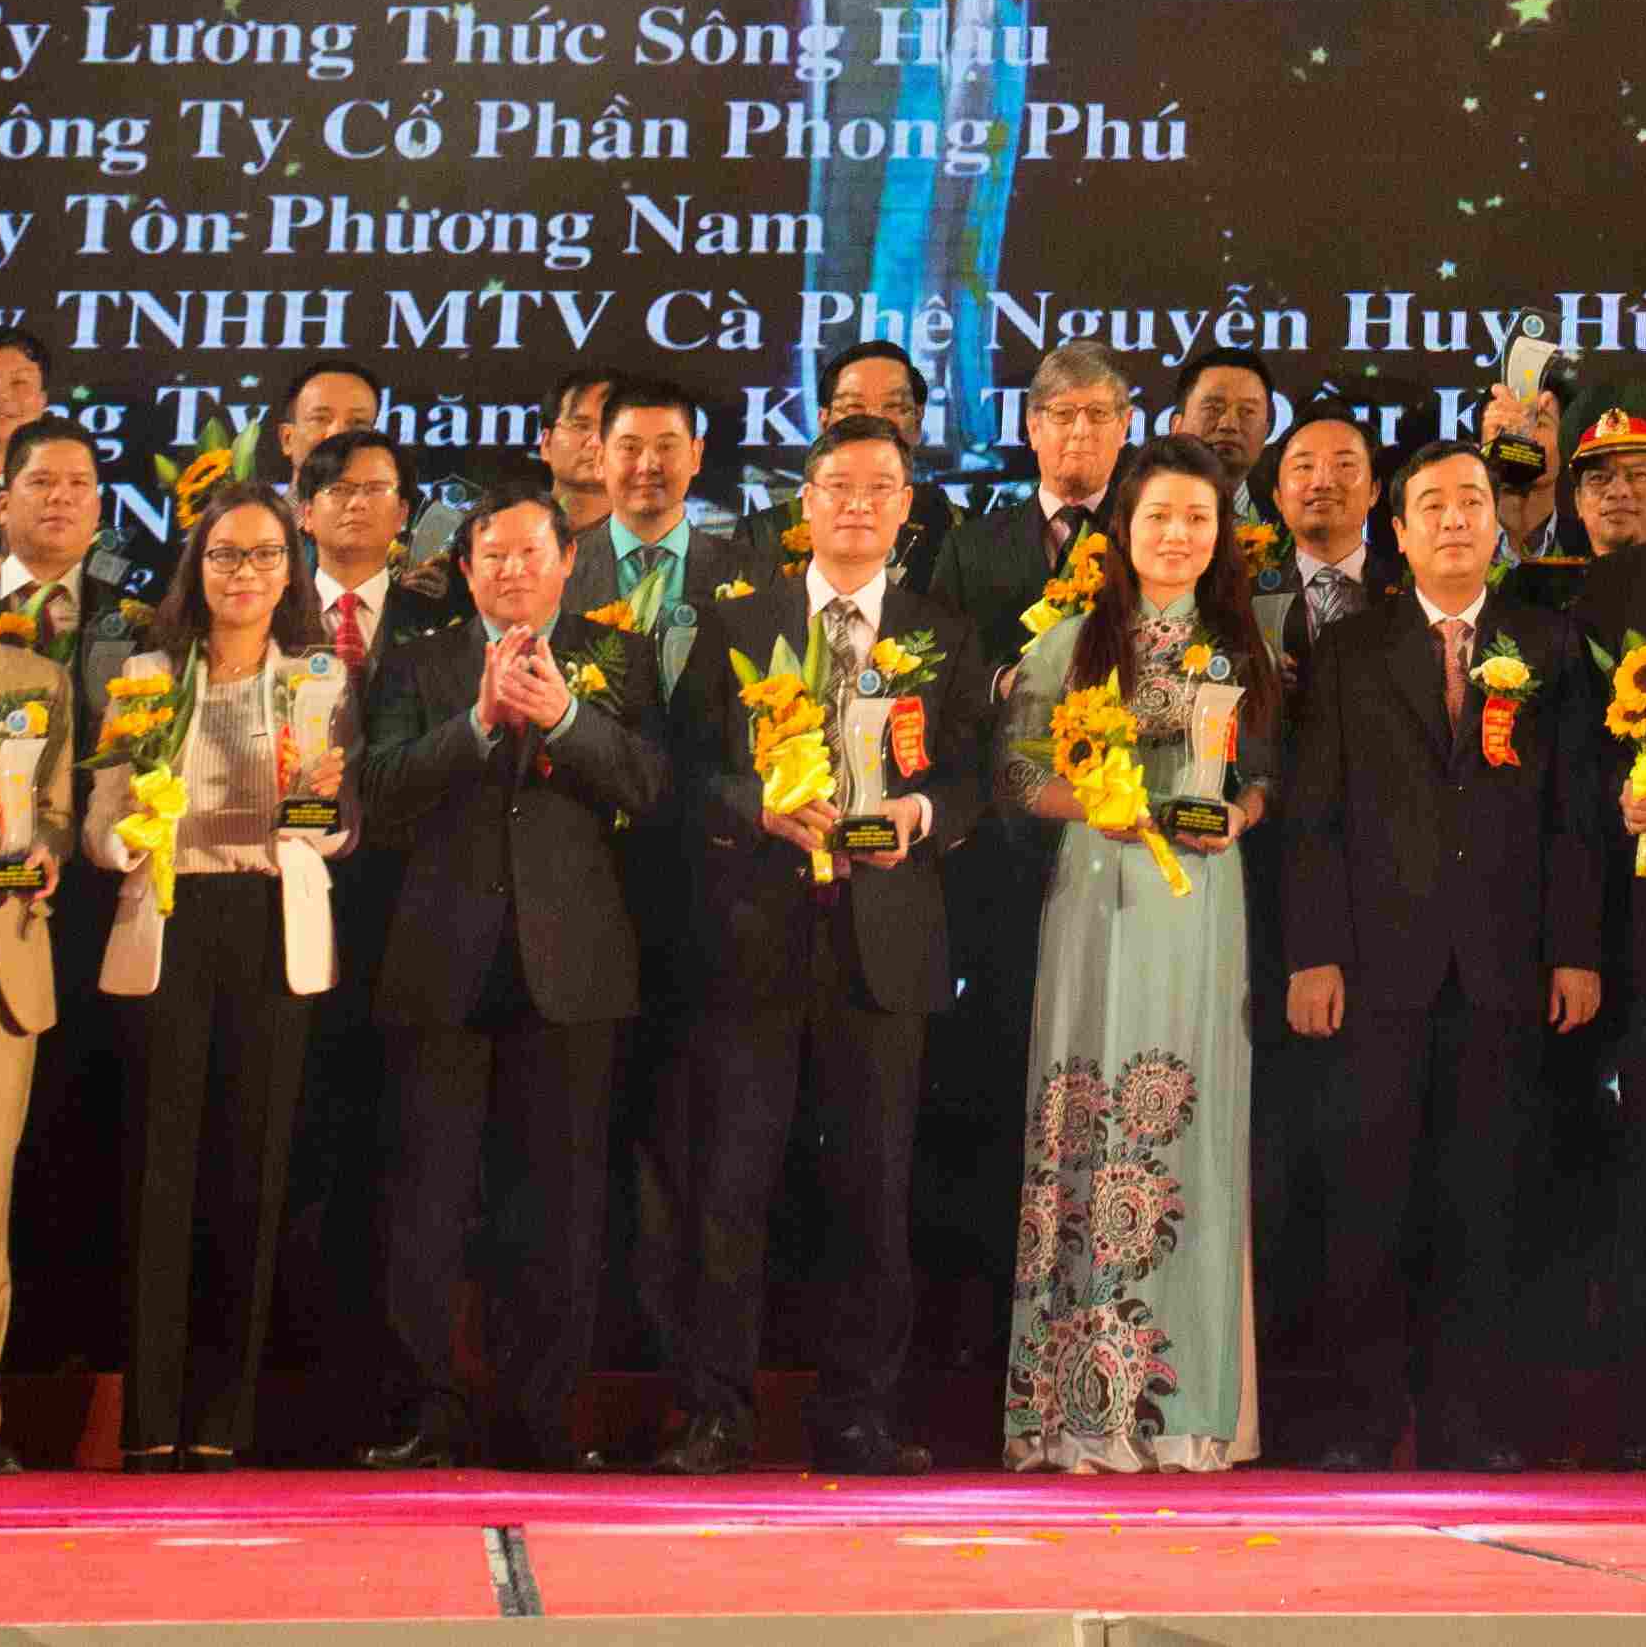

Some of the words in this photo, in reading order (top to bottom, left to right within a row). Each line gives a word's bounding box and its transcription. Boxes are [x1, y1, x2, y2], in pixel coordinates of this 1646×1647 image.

[82, 5, 357, 81] Lương
[387, 4, 606, 65] Thức
[634, 6, 843, 82] Sông
[180, 100, 291, 174] Ty
[323, 89, 444, 159] Cổ
[474, 95, 688, 160] Phần
[724, 101, 992, 176] Phong
[1022, 102, 1187, 162] Phú
[65, 194, 235, 254] Tôn
[264, 195, 594, 270] Phương
[623, 195, 825, 255] Nam
[57, 290, 352, 349] TNHH
[383, 291, 615, 350] MTV
[646, 290, 763, 350] Cà
[792, 291, 955, 352] Phê
[986, 283, 1309, 366] Nguyễn
[1344, 292, 1520, 368] Huy
[375, 386, 541, 447] hăm
